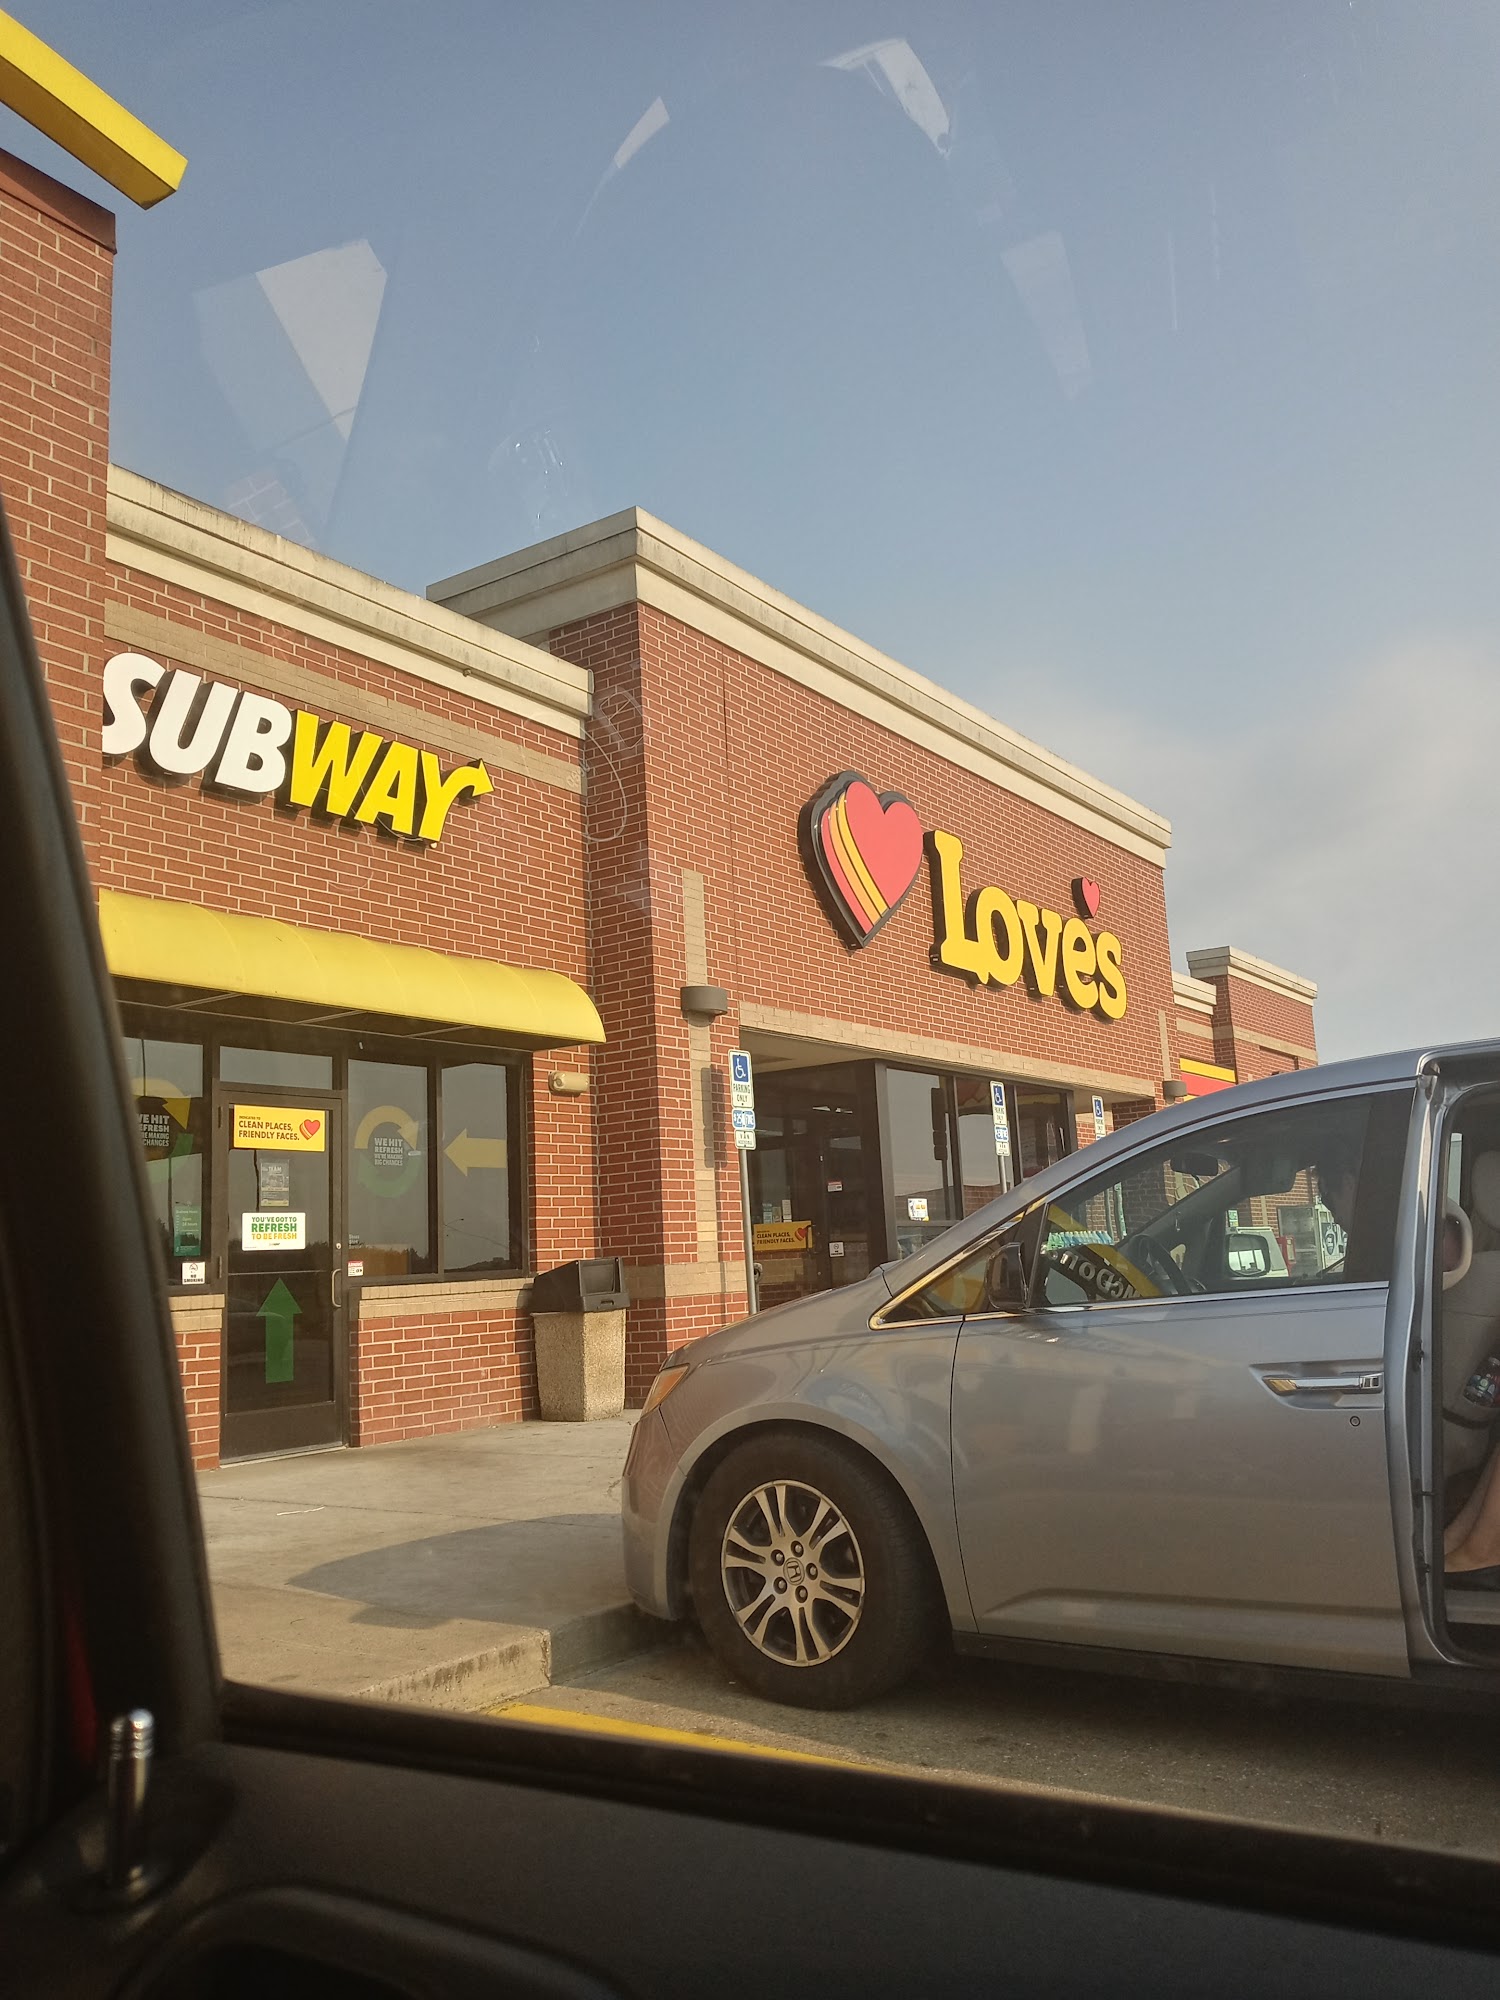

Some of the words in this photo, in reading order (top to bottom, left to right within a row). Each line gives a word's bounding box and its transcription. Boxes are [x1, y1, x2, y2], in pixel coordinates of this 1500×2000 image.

[102, 653, 494, 842] SUBWAY
[733, 1083, 750, 1094] PARKING
[737, 1094, 748, 1102] ONLY
[151, 1114, 170, 1124] HIT
[239, 1120, 263, 1129] CLEAN
[265, 1122, 293, 1131] PLACES,
[239, 1130, 275, 1139] FRIENDLY
[276, 1132, 299, 1140] FACES.
[143, 1139, 170, 1147] CHANGES
[374, 1137, 388, 1146] WE
[388, 1138, 403, 1147] HIT
[251, 1223, 297, 1232] REFRESH
